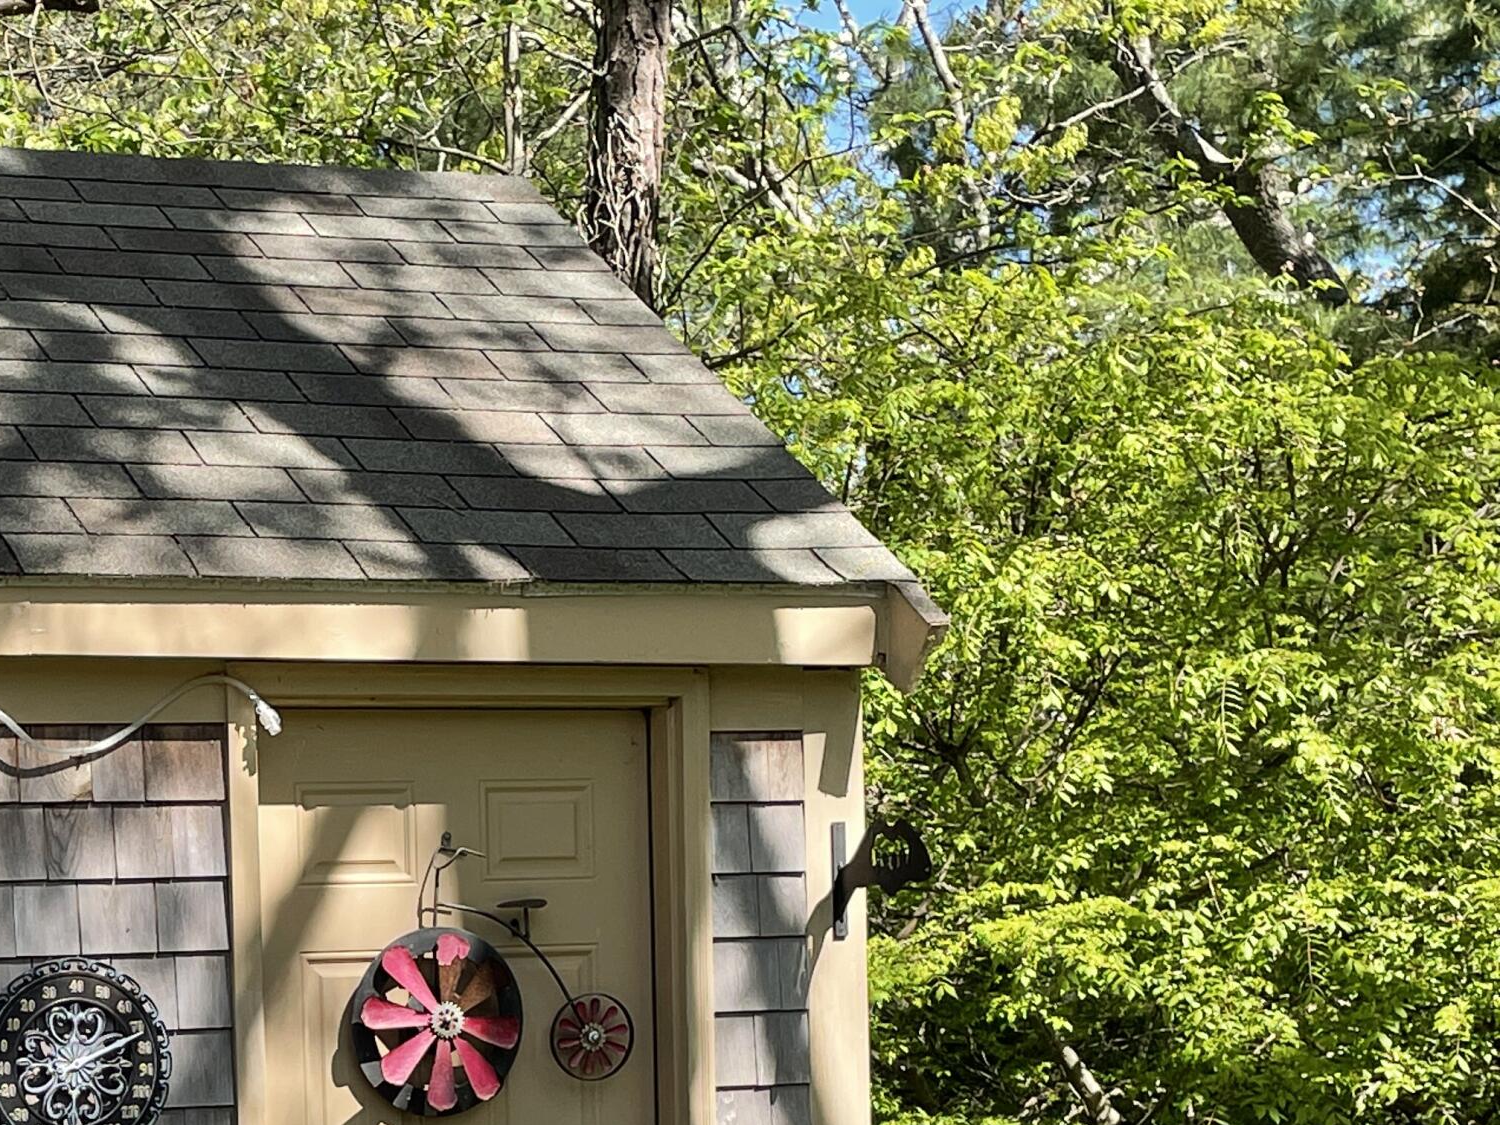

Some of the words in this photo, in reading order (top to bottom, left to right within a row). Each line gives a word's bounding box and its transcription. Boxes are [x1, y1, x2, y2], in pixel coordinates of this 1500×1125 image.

[42, 986, 57, 999] 30
[69, 980, 84, 993] 40
[20, 999, 36, 1012] 20
[6, 1018, 20, 1031] 10
[0, 1039, 8, 1053] 0
